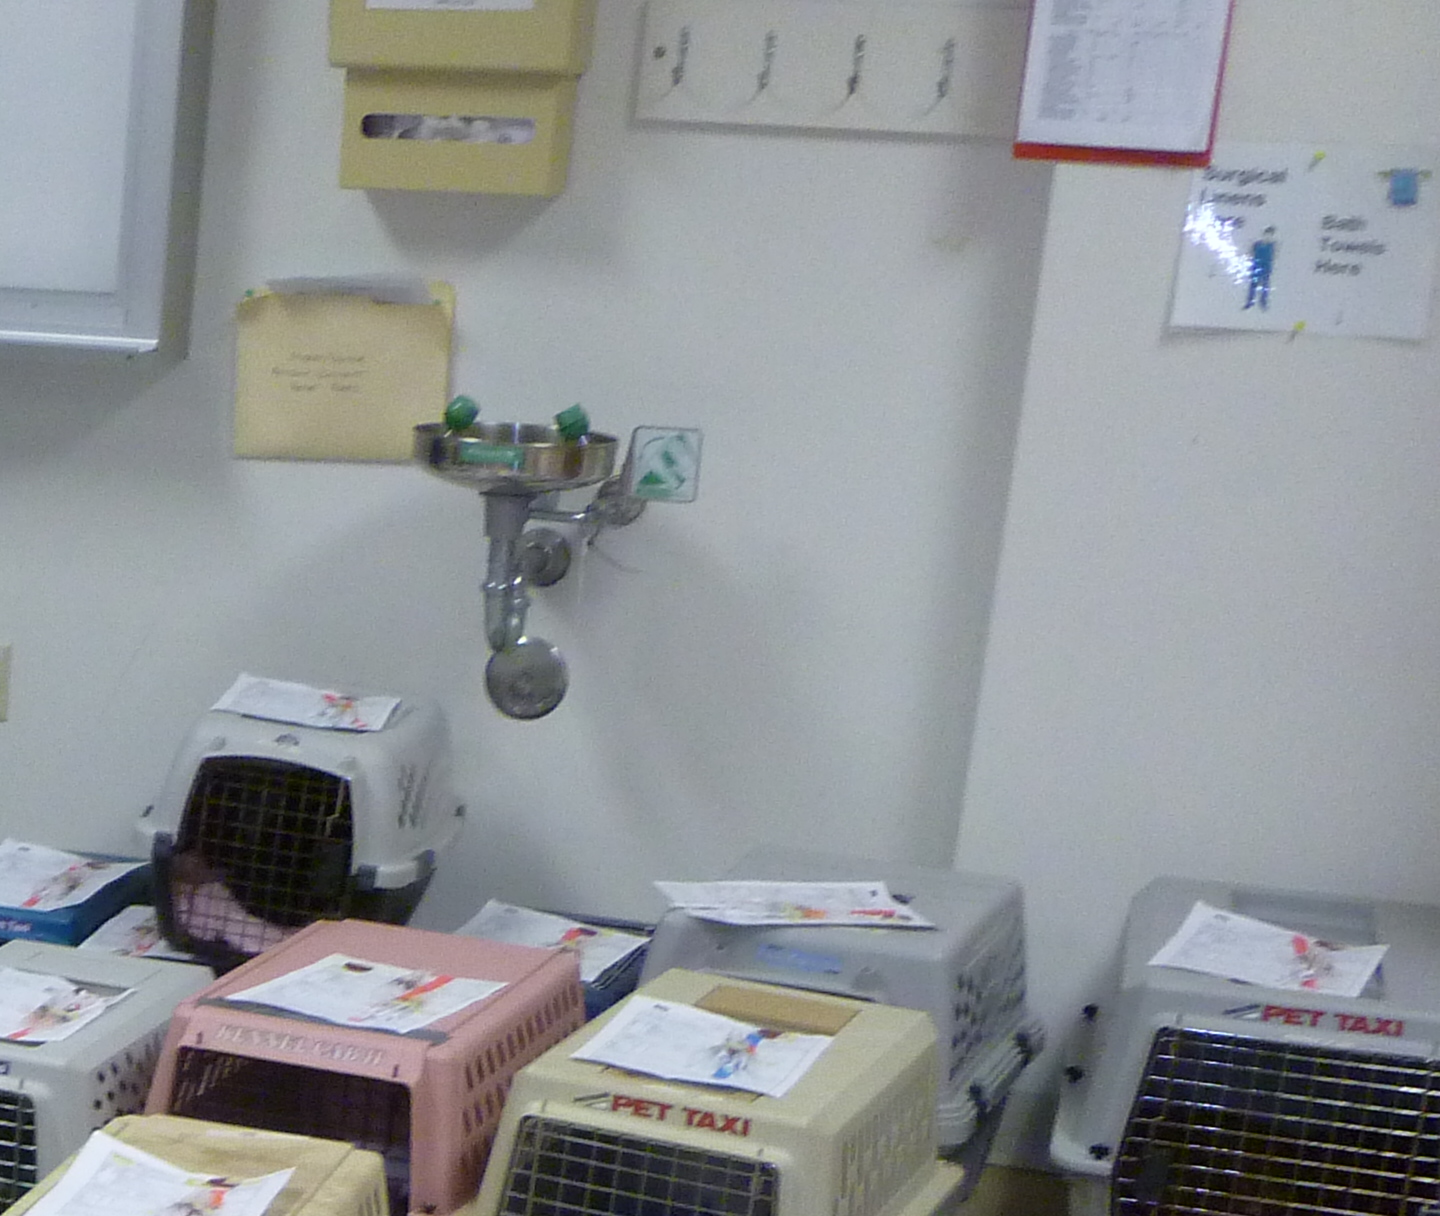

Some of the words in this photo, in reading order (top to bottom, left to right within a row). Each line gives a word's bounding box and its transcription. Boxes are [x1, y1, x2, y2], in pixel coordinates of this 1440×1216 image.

[1203, 166, 1289, 186] Surgical
[1320, 236, 1388, 256] Towels
[1313, 258, 1362, 277] Here
[1261, 1004, 1327, 1027] PET
[1333, 1013, 1406, 1038] TAXI
[610, 1094, 674, 1122] PET
[682, 1105, 753, 1138] TAXI
